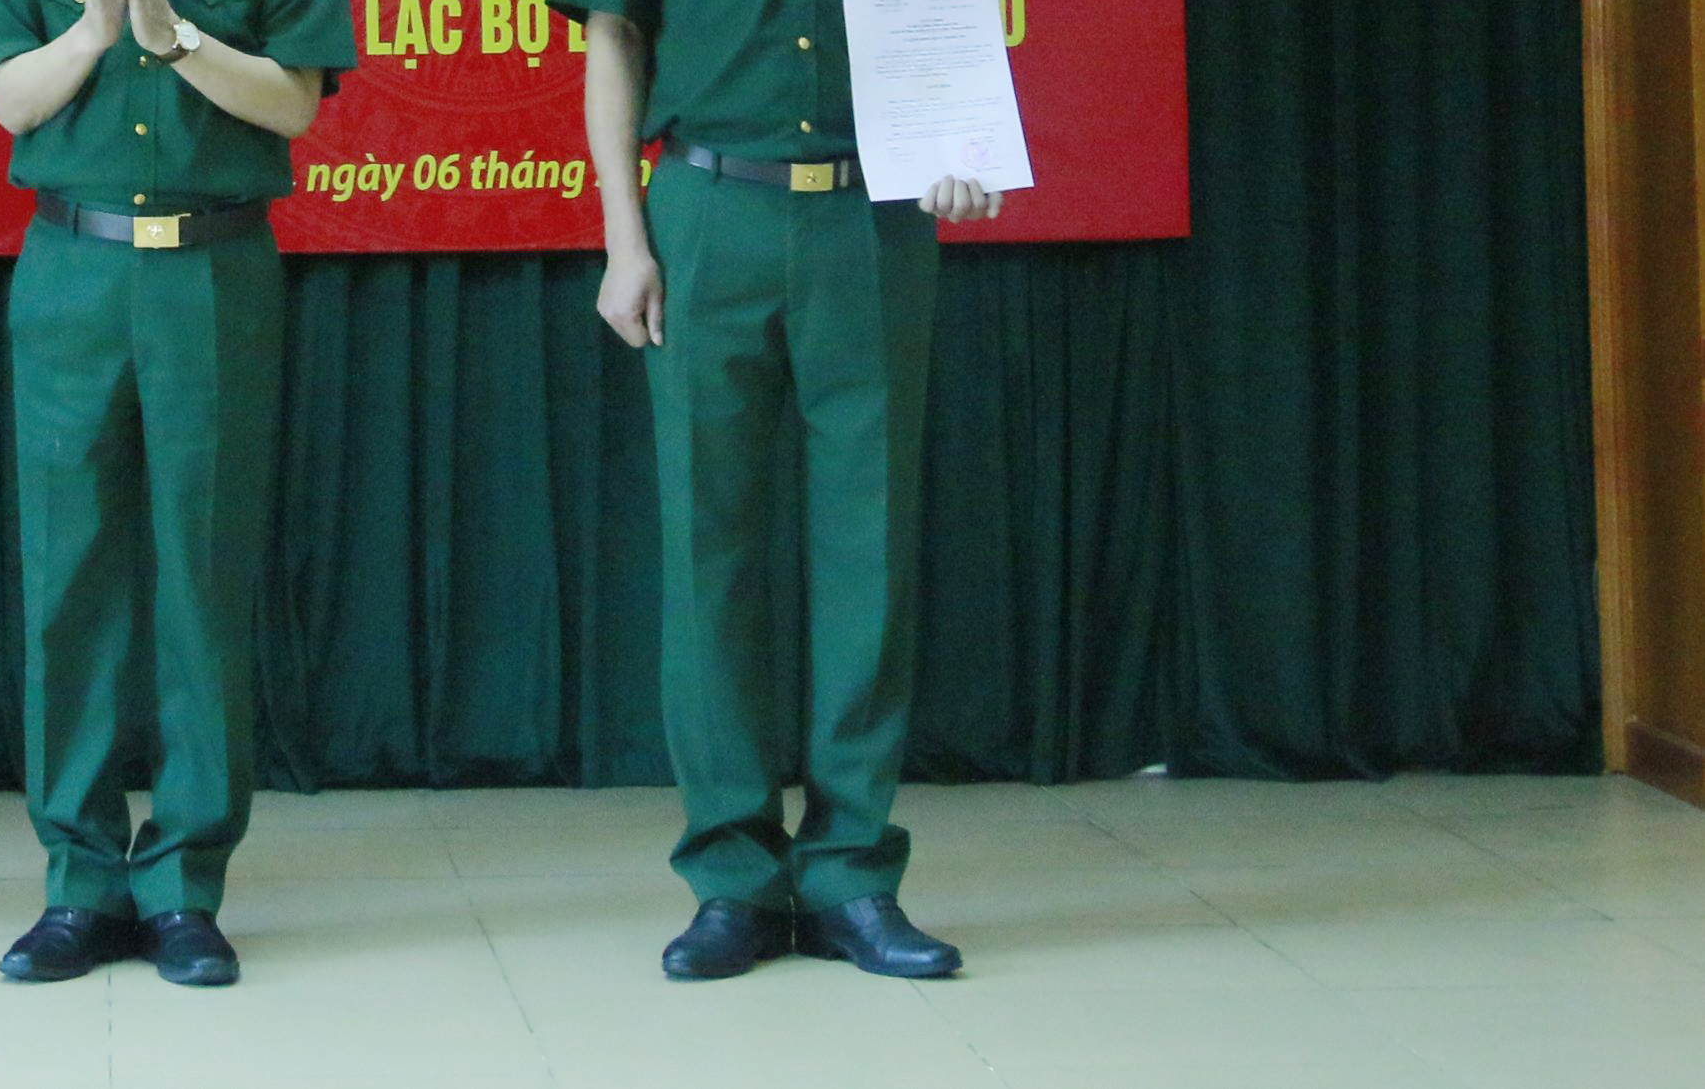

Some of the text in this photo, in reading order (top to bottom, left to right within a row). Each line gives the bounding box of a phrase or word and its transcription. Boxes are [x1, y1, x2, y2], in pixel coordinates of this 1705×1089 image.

[306, 153, 406, 203] ngày
[412, 153, 462, 191] 06
[470, 149, 587, 200] tháng
